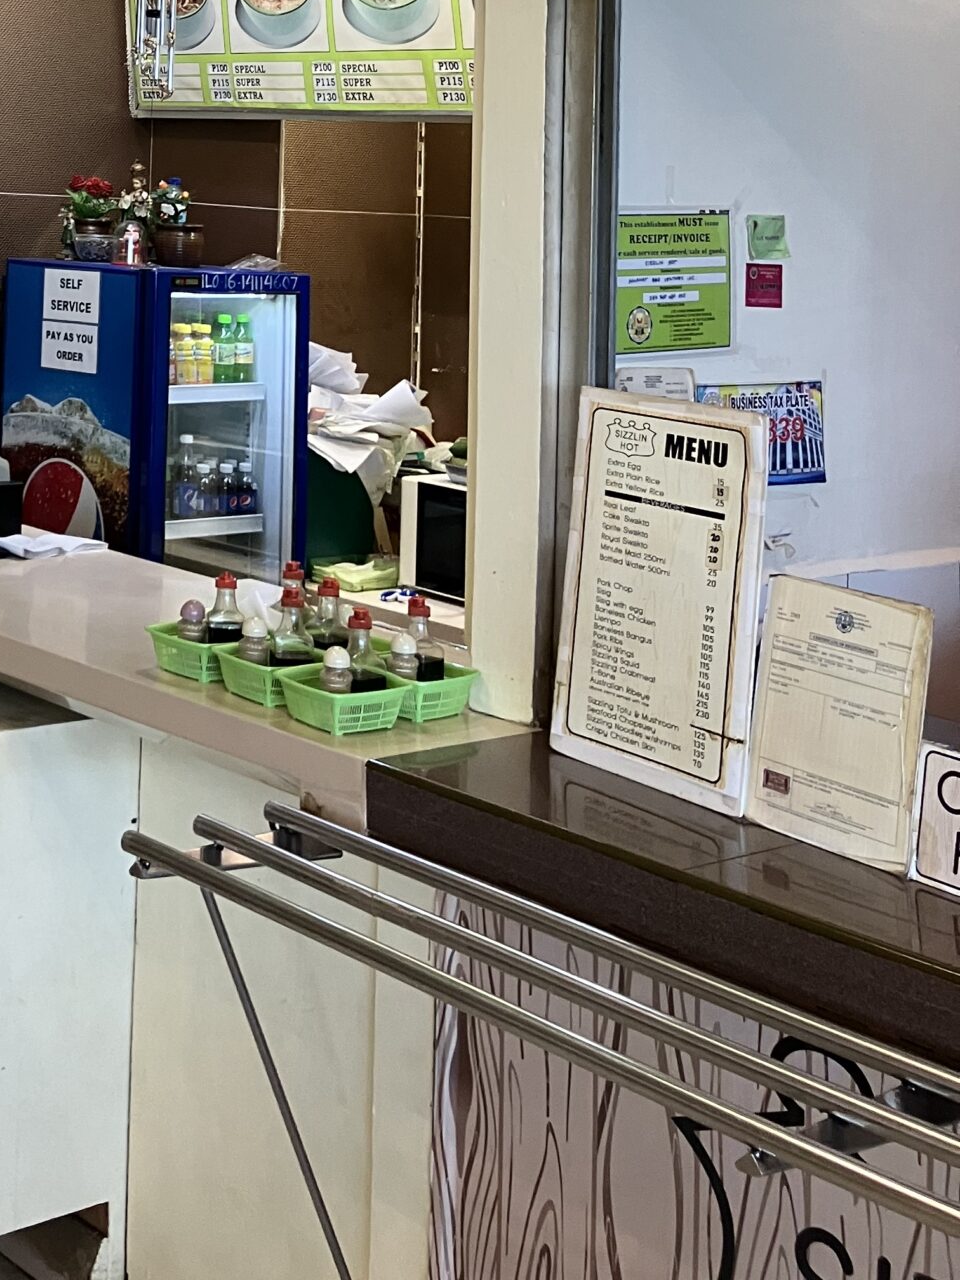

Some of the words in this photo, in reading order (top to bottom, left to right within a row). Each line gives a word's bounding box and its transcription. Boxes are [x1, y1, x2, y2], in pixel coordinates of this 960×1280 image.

[211, 64, 228, 73] P100
[234, 65, 266, 74] SPECIAL
[313, 63, 333, 72] P100
[341, 63, 378, 73] SPECIAL
[438, 61, 460, 71] P100
[212, 78, 230, 87] P115
[214, 91, 232, 100] P130
[235, 78, 261, 87] SUPER
[315, 78, 336, 87] P115
[343, 78, 372, 87] SUPER
[439, 76, 463, 86] P115
[237, 91, 264, 100] EXTRA
[316, 92, 337, 102] P130
[345, 91, 375, 101] EXTRA
[442, 91, 466, 102] P130
[678, 217, 703, 227] MUST
[629, 233, 711, 245] RECEIPT/INVOICE
[59, 278, 83, 290] SELF
[50, 299, 92, 314] SERVICE
[45, 330, 62, 340] PAY
[63, 332, 74, 342] AS
[76, 334, 93, 344] YOU
[56, 350, 83, 362] ORDER
[730, 395, 767, 410] BUSINESS
[768, 395, 784, 408] TAX
[785, 394, 809, 408] PLATE
[614, 429, 647, 442] SIZZLIN
[620, 442, 639, 452] HOT
[664, 433, 729, 468] MENU
[606, 468, 624, 479] Extra
[626, 472, 643, 482] Plain
[645, 476, 661, 485] Rice
[607, 458, 626, 468] Extra
[627, 462, 642, 472] Egg
[717, 478, 724, 486] 15
[605, 479, 623, 489] Extra
[625, 483, 647, 494] Yellow
[649, 487, 665, 497] Rice
[715, 498, 725, 507] 25
[603, 500, 618, 510] Real
[619, 503, 637, 513] Leaf
[713, 522, 722, 531] 35
[603, 511, 620, 521] Coke
[601, 532, 621, 544] Royal
[602, 522, 621, 533] Sprite
[709, 545, 719, 554] 20
[599, 553, 624, 566] Bottled
[625, 559, 646, 570] Water
[706, 579, 717, 588] 20
[600, 542, 623, 555] Minute
[625, 548, 641, 559] Maid
[707, 568, 717, 577] 25
[596, 577, 611, 587] Pork
[613, 581, 633, 593] Chop
[705, 605, 715, 614] 99
[596, 587, 612, 598] Sisig
[704, 615, 714, 623] 99
[595, 596, 611, 607] Sisig
[612, 600, 627, 610] with
[628, 605, 644, 616] egg
[702, 624, 715, 633] 105
[595, 604, 626, 619] Boneless
[627, 613, 657, 627] Chicken
[702, 633, 714, 643] 105
[593, 622, 625, 637] Boneless
[626, 630, 652, 645] Bangus
[700, 652, 713, 662] 105
[594, 613, 622, 627] Liempo
[701, 643, 713, 653] 105
[592, 639, 612, 653] Spicy
[614, 646, 635, 659] Wings
[699, 671, 709, 681] 115
[593, 630, 608, 641] Pork
[609, 635, 623, 646] Ribs
[700, 661, 710, 671] 115
[591, 649, 619, 664] Sizzling
[620, 656, 640, 669] Squid
[697, 680, 711, 690] 140
[591, 658, 617, 673] Sizzling
[620, 666, 656, 683] Crabmeat
[697, 690, 710, 701] 145
[590, 666, 616, 681] T-Bone
[696, 699, 709, 709] 215
[590, 676, 624, 693] Australian
[625, 686, 651, 702] Ribeye
[695, 709, 710, 720] 230
[587, 696, 614, 711] Sizzling
[617, 704, 632, 716] Tofu
[641, 713, 680, 732] Mushroom
[694, 730, 706, 741] 125
[587, 704, 617, 720] Seafood
[618, 715, 657, 734] Chopsuey
[693, 740, 706, 751] 135
[585, 723, 608, 738] Crispy
[610, 731, 640, 748] Chicken
[641, 742, 657, 754] Skin
[692, 759, 702, 769] 70
[586, 713, 613, 729] Sizzling
[614, 723, 643, 739] Noodles
[693, 749, 705, 760] 135
